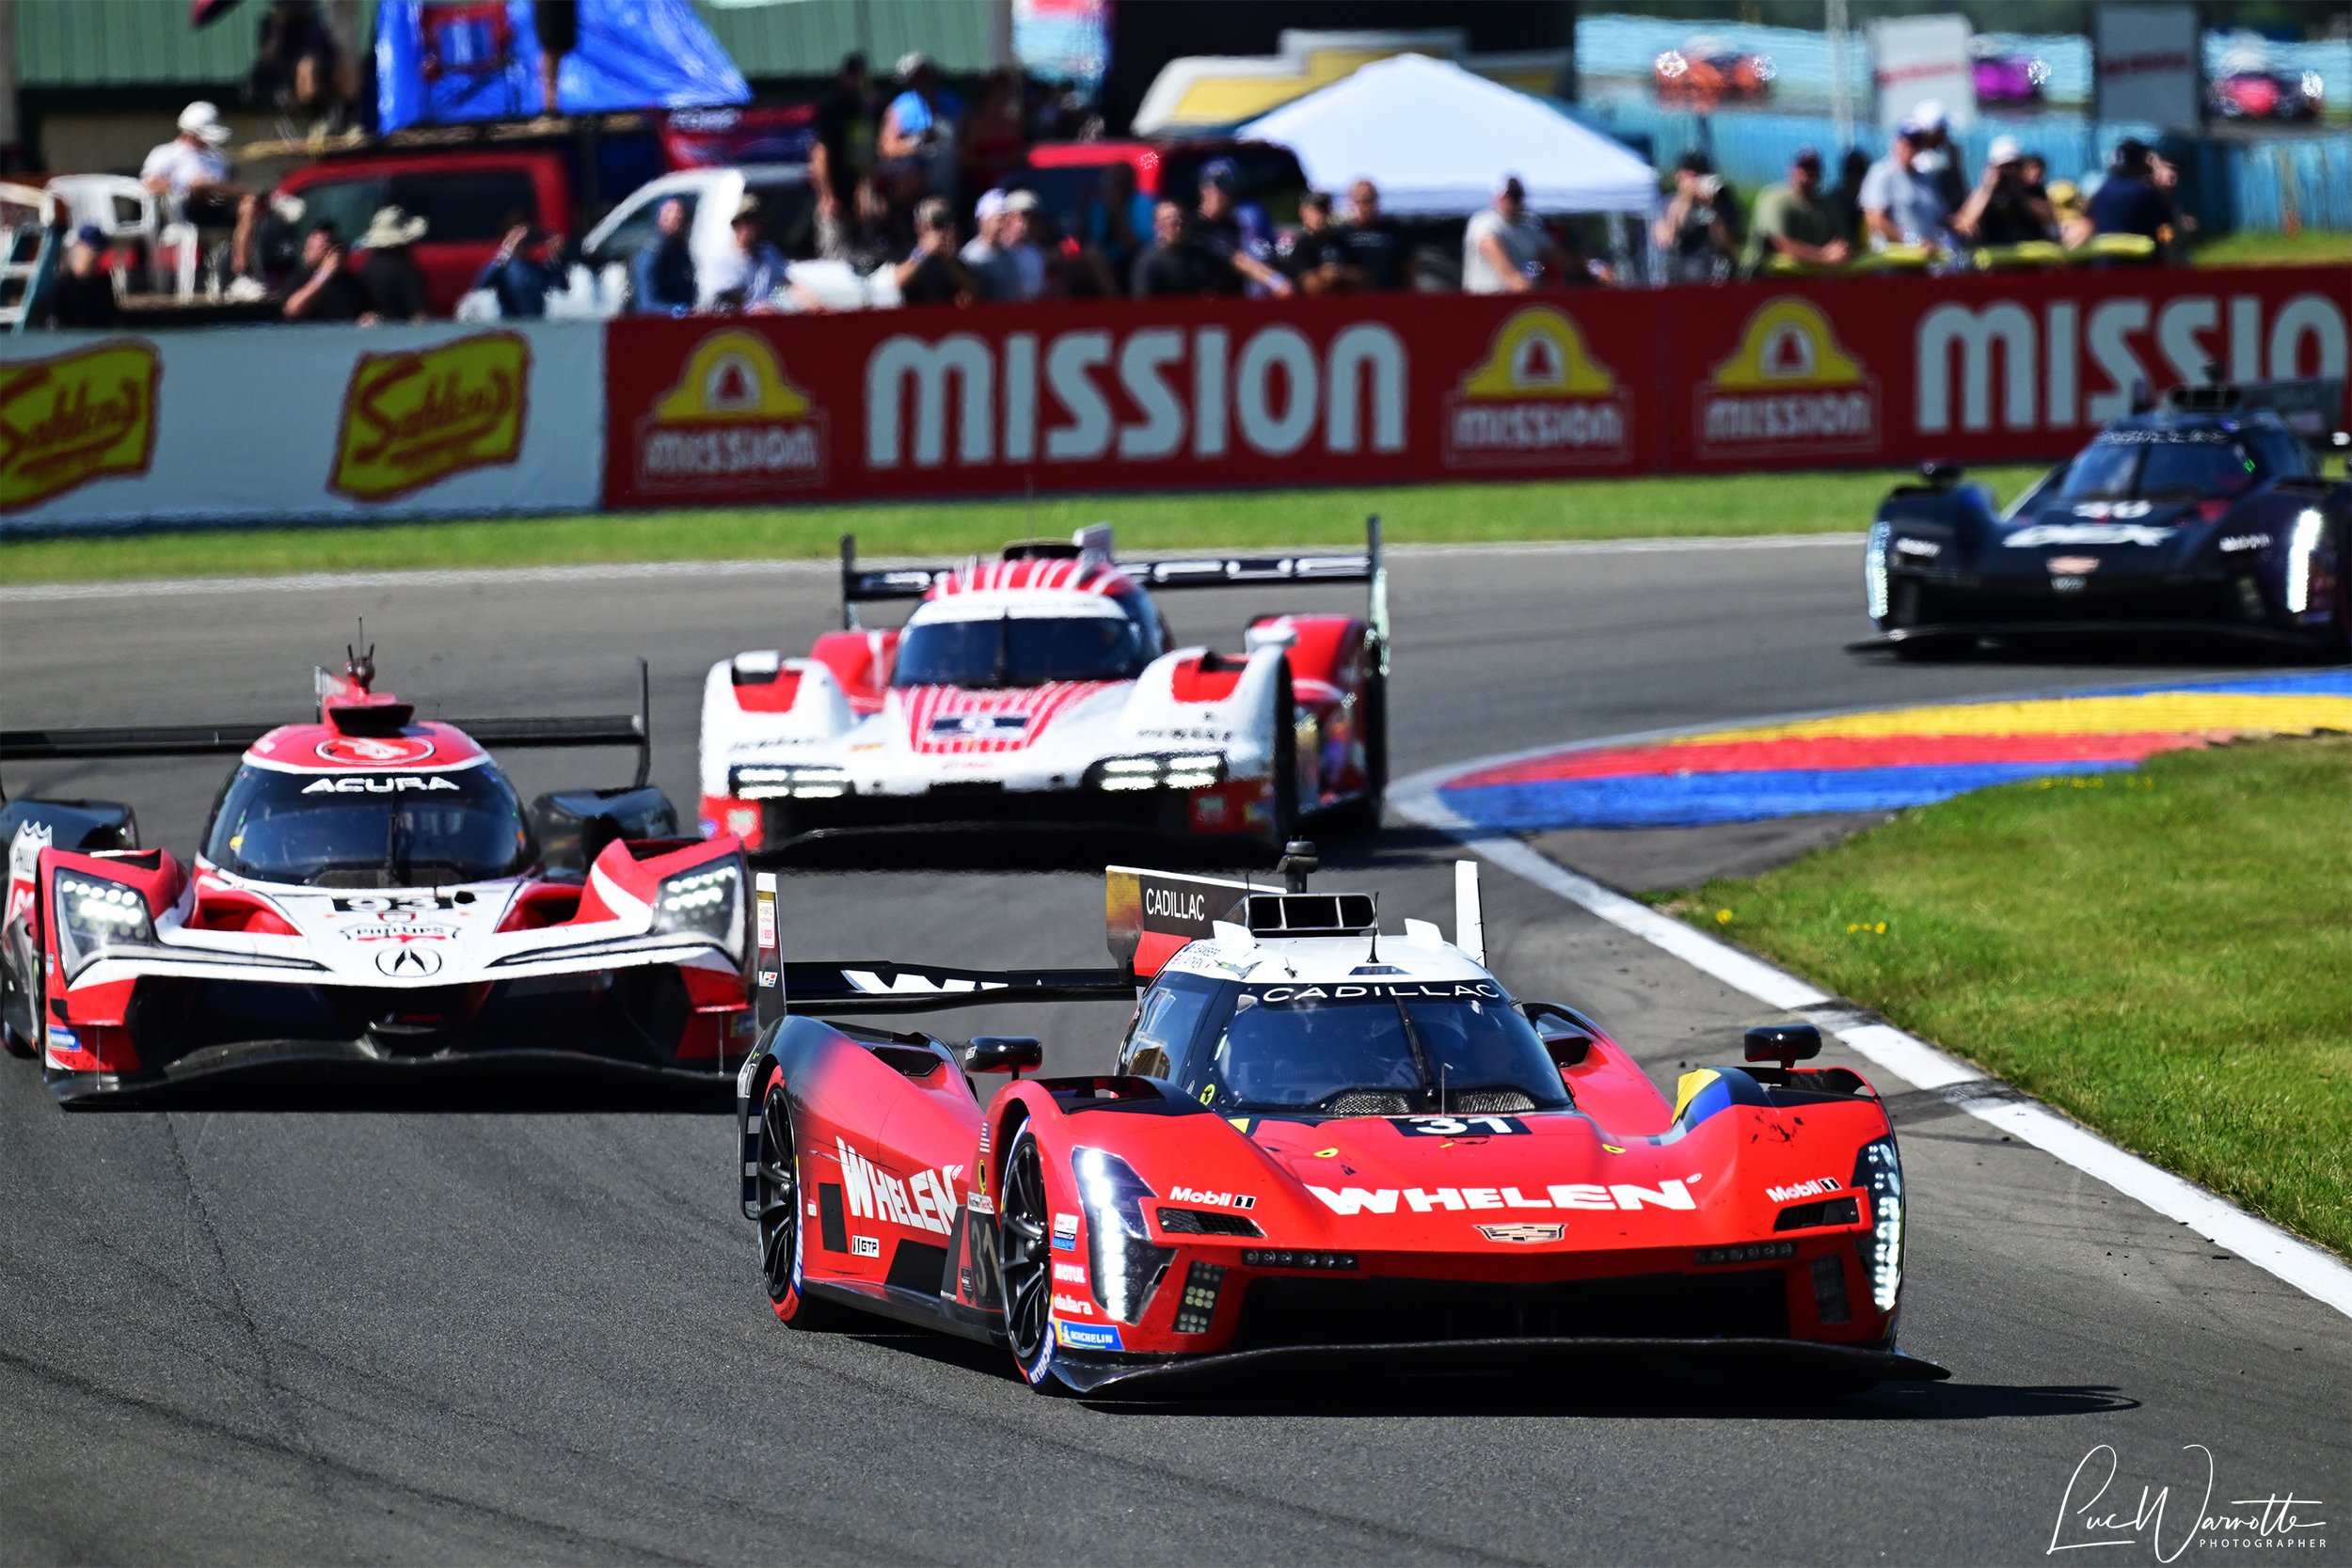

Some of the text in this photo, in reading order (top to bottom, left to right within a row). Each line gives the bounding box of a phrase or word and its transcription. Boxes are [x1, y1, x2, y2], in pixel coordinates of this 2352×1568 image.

[1916, 294, 2349, 434] MISSIO
[866, 323, 1407, 468] MISSION
[1453, 404, 1624, 450] MISSION
[1705, 391, 1871, 440] MISSION
[644, 427, 817, 473] MISSION
[301, 776, 460, 794] ACURA
[1146, 888, 1205, 922] CADILLAC
[1263, 985, 1500, 1003] CADILLAC
[1409, 1117, 1513, 1134] 31
[835, 1135, 957, 1236] WHELEN
[1169, 1186, 1232, 1207] Mobil
[1303, 1180, 1696, 1214] WHELEN
[1766, 1180, 1822, 1203] Mobil
[861, 1240, 879, 1254] GTP
[1055, 1263, 1087, 1284] MOTUL
[1071, 1330, 1114, 1344] MICHELIN
